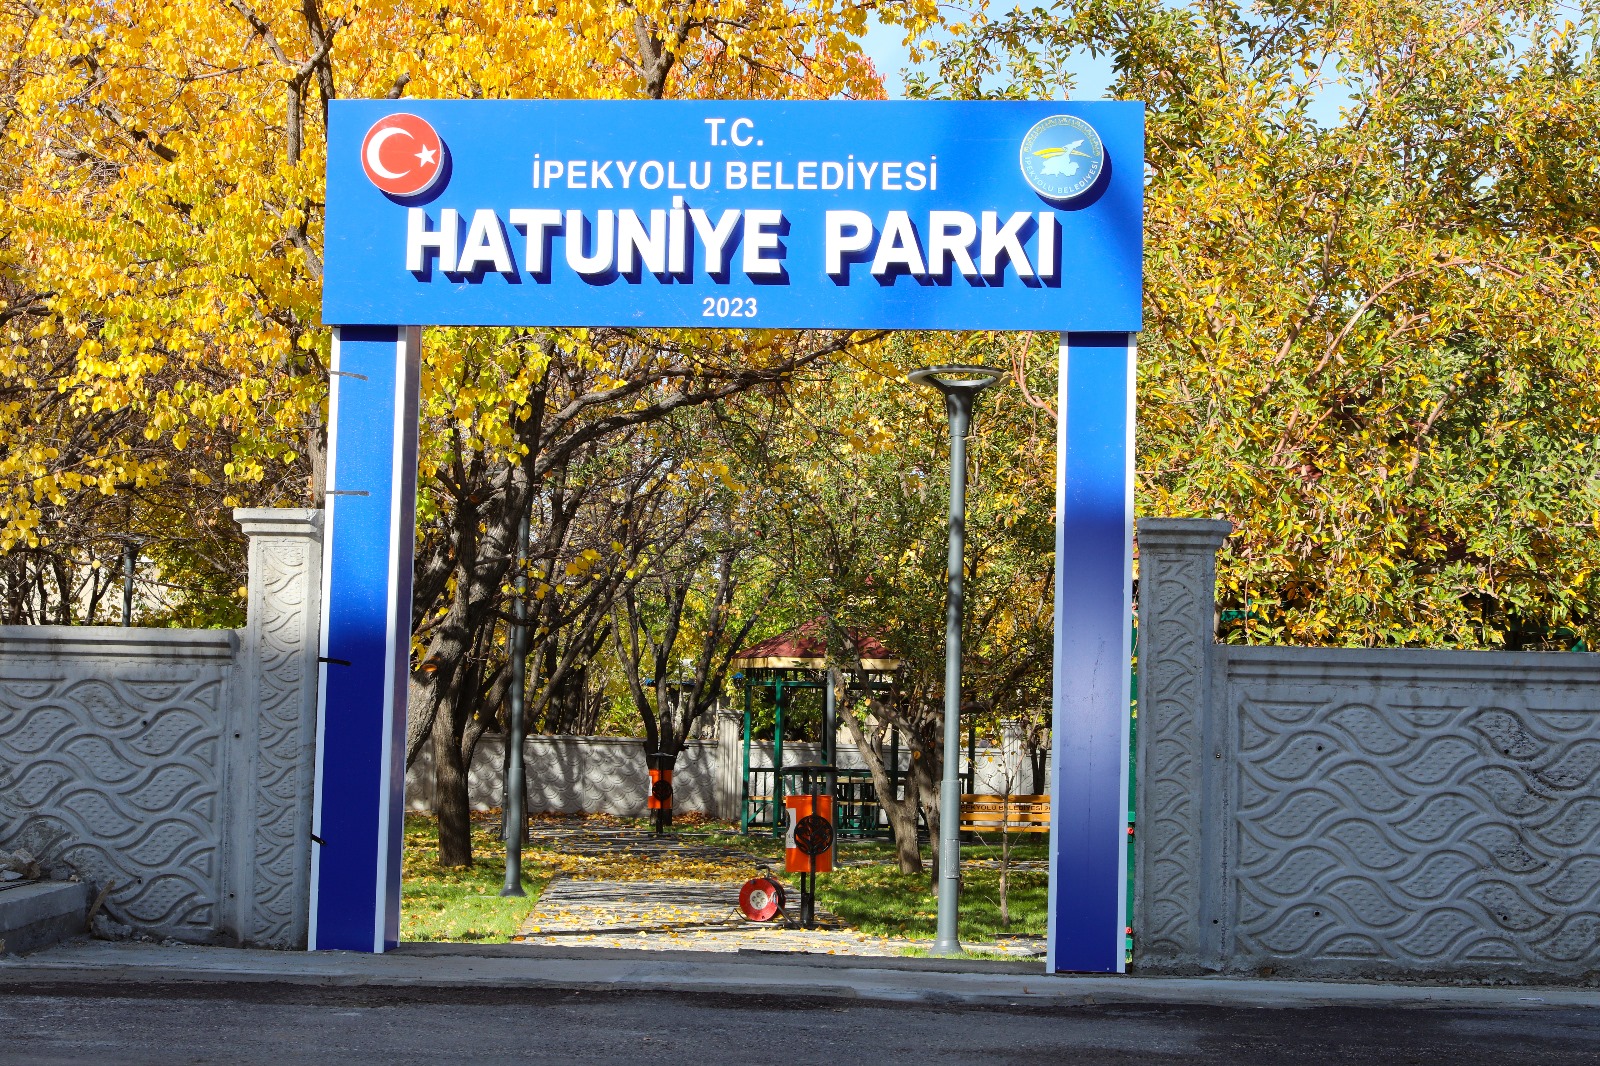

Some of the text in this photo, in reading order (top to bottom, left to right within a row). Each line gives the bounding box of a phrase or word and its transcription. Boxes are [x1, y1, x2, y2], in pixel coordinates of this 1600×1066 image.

[704, 117, 764, 147] T.C.
[532, 153, 938, 191] İPEKYOLU BELEDİYESİ
[405, 195, 1056, 277] HATUNİYE PARKI
[702, 297, 758, 318] 2023
